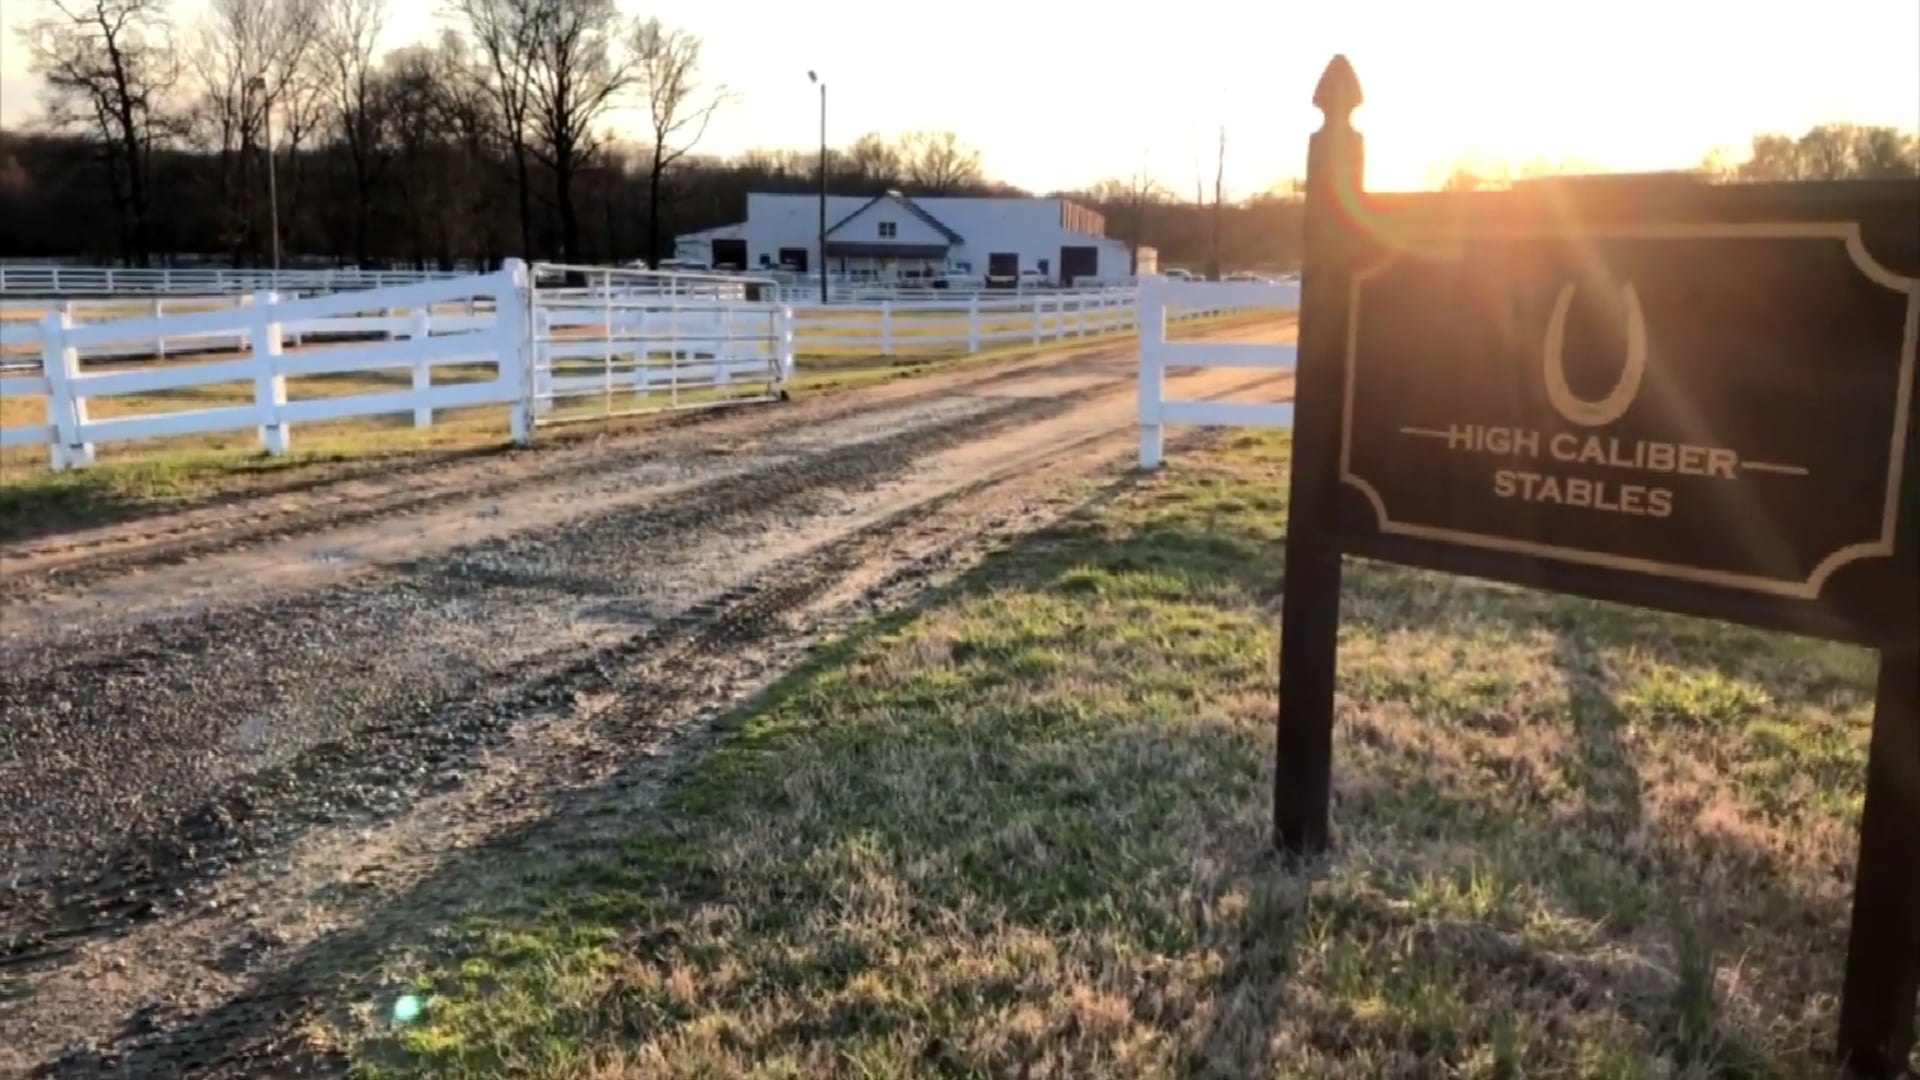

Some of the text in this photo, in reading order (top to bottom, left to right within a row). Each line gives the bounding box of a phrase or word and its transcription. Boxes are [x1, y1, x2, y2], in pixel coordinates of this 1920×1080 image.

[1447, 424, 1738, 479] HIGH CALIBER
[1493, 470, 1673, 517] STABLES
